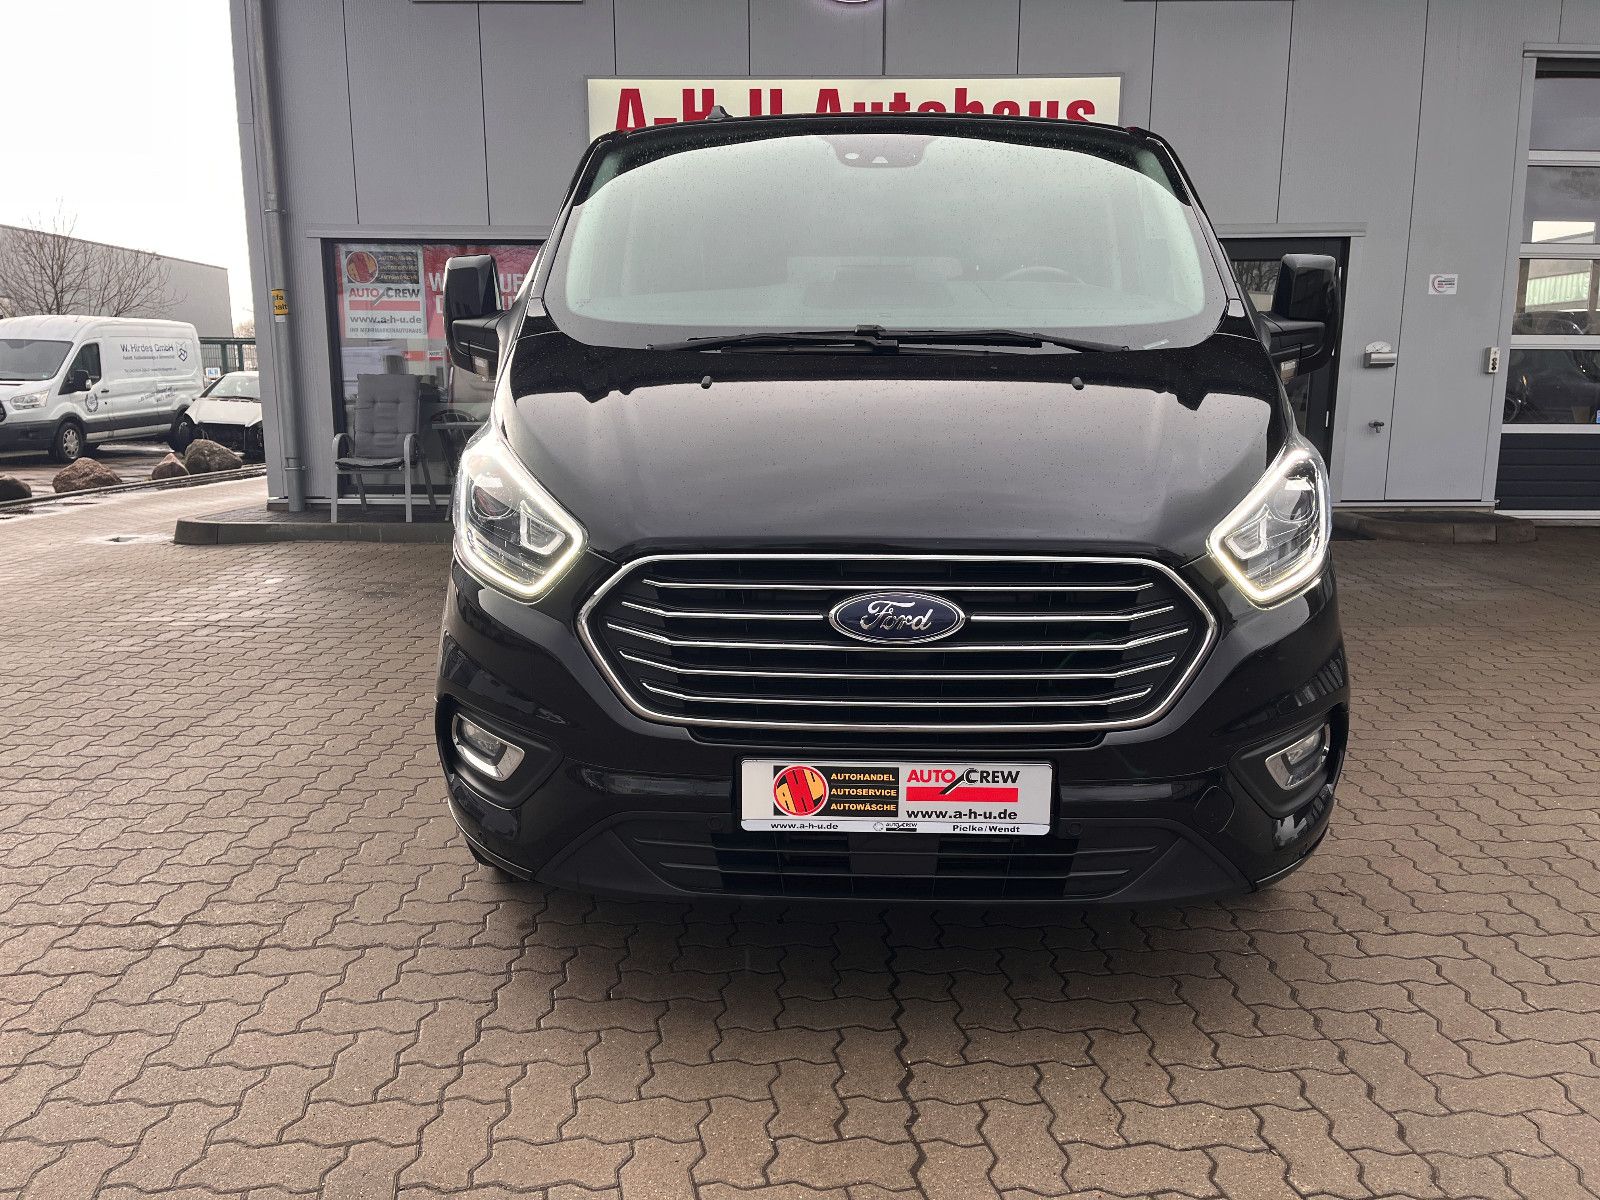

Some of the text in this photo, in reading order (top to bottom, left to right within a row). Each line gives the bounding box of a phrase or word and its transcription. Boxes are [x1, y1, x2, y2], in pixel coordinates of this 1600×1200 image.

[349, 287, 421, 298] AUTO CREW
[350, 315, 422, 324] www.a-h-u.de
[154, 343, 174, 352] GmbH
[860, 600, 933, 631] Ford
[830, 773, 896, 781] AUTOHANDEL
[906, 768, 1020, 784] AUTO CREW
[830, 788, 897, 797] AUTOSERVICE
[830, 802, 897, 811] AUTOWÄSCHE
[906, 809, 1018, 820] www.a-h-u.de
[770, 822, 839, 830] www.a-h-u.de
